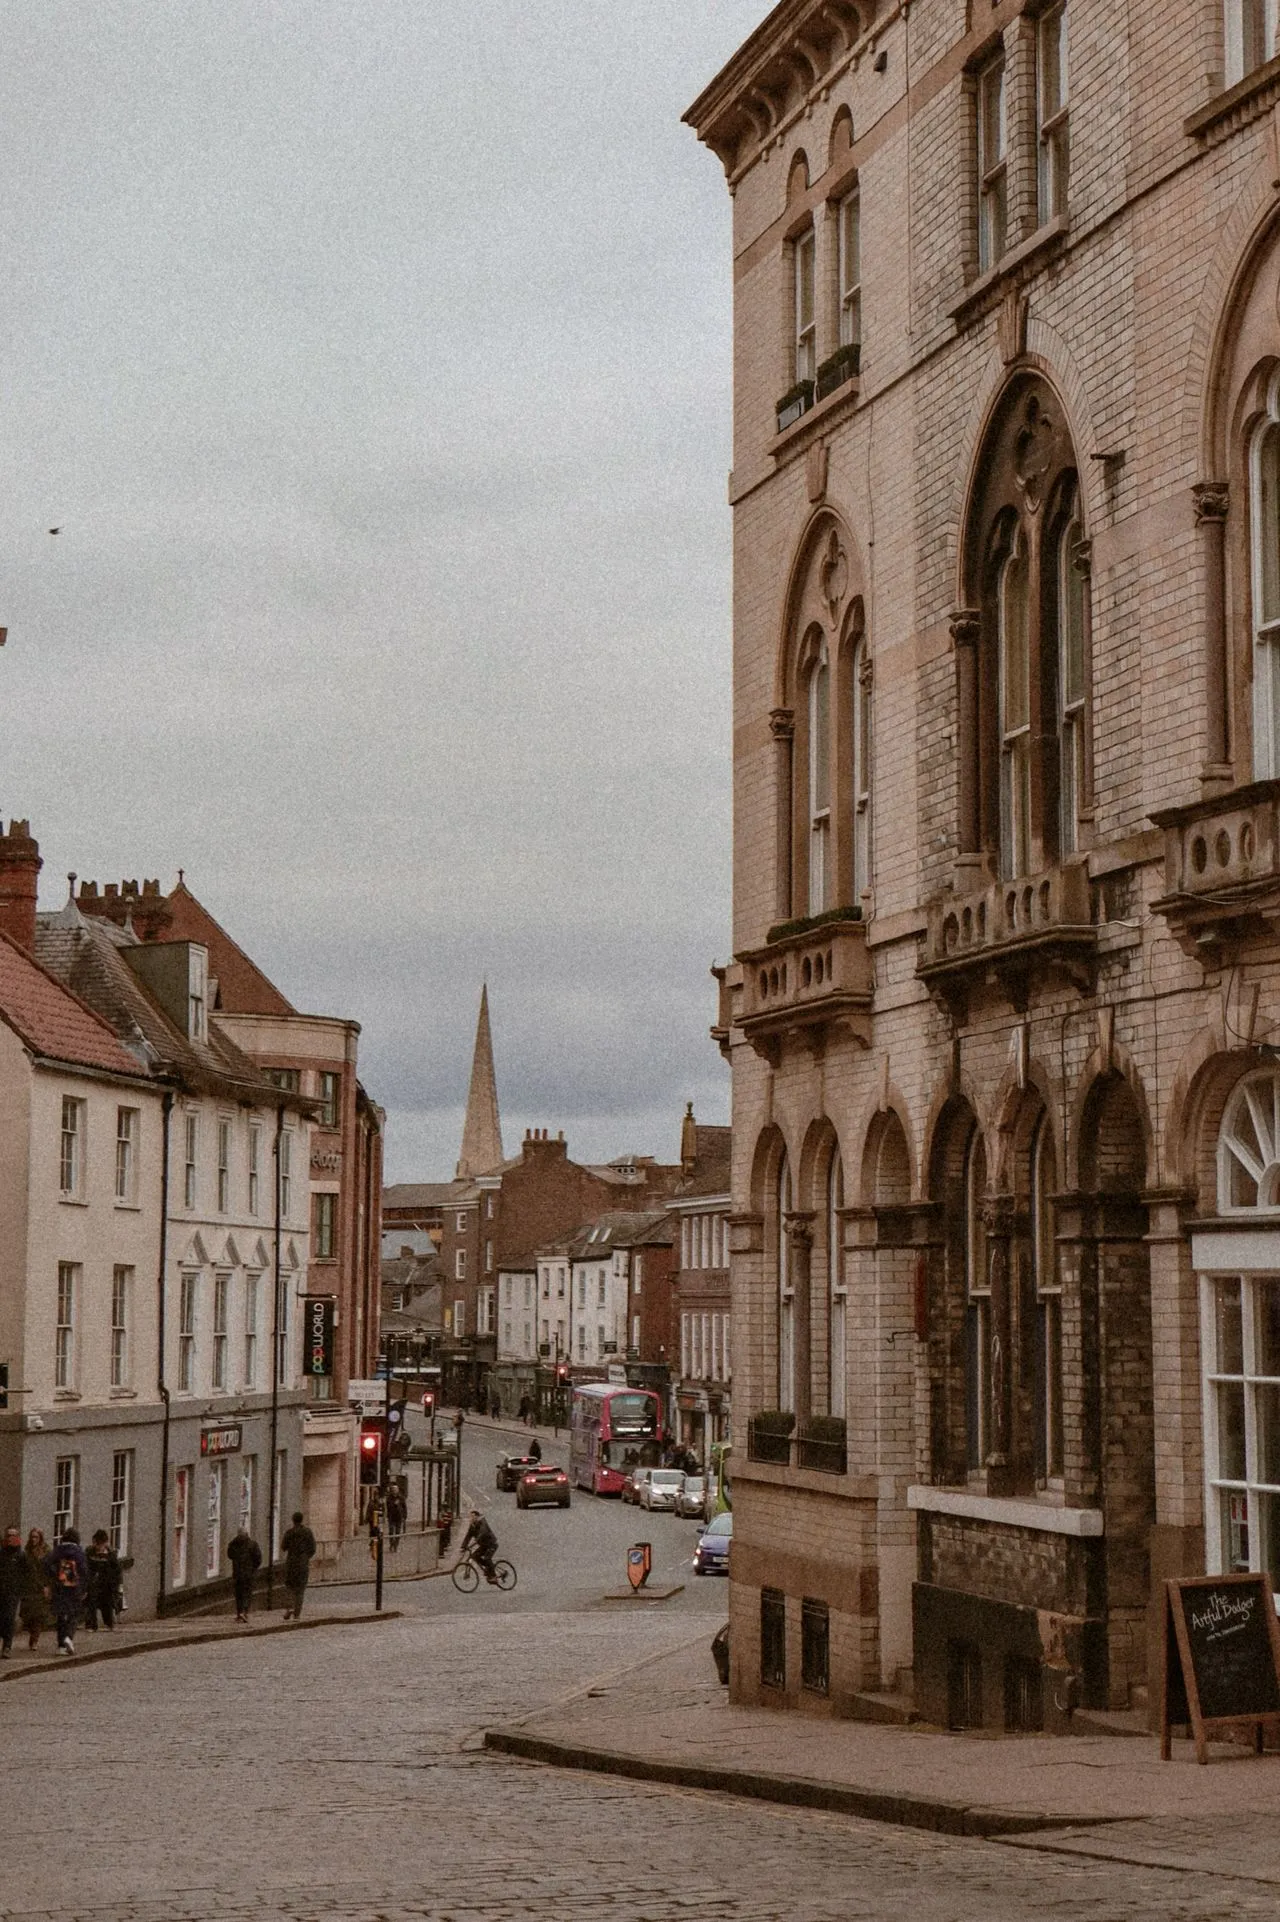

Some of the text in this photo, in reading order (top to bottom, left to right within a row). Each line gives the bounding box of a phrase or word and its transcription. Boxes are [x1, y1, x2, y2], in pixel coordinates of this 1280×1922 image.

[1208, 1592, 1228, 1608] The
[1192, 1597, 1256, 1631] Artful Dodger
